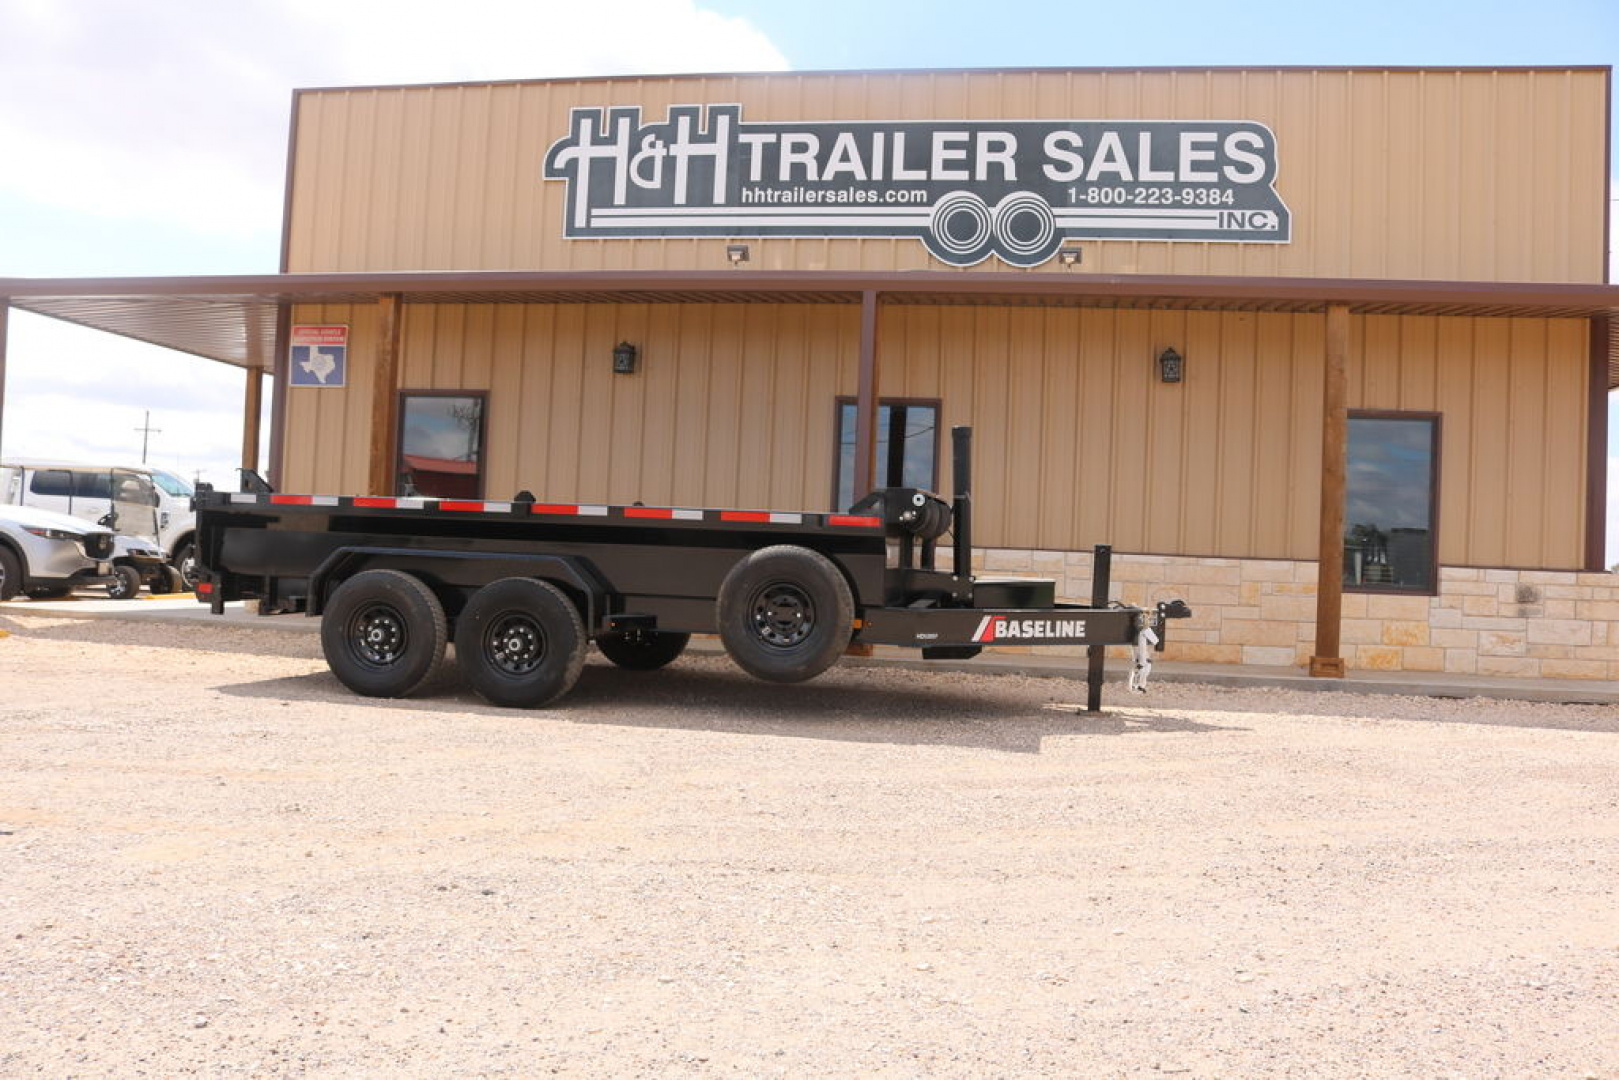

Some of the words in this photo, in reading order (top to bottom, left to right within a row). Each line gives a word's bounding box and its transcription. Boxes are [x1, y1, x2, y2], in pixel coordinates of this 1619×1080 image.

[553, 114, 730, 228] H&H
[738, 131, 1018, 182] TRAILER
[1042, 130, 1266, 184] SALES
[741, 187, 928, 203] hhtrailersales.com
[1067, 187, 1235, 205] 1-800-223-9384
[1217, 211, 1276, 230] INC.
[994, 620, 1086, 638] BASELINE
